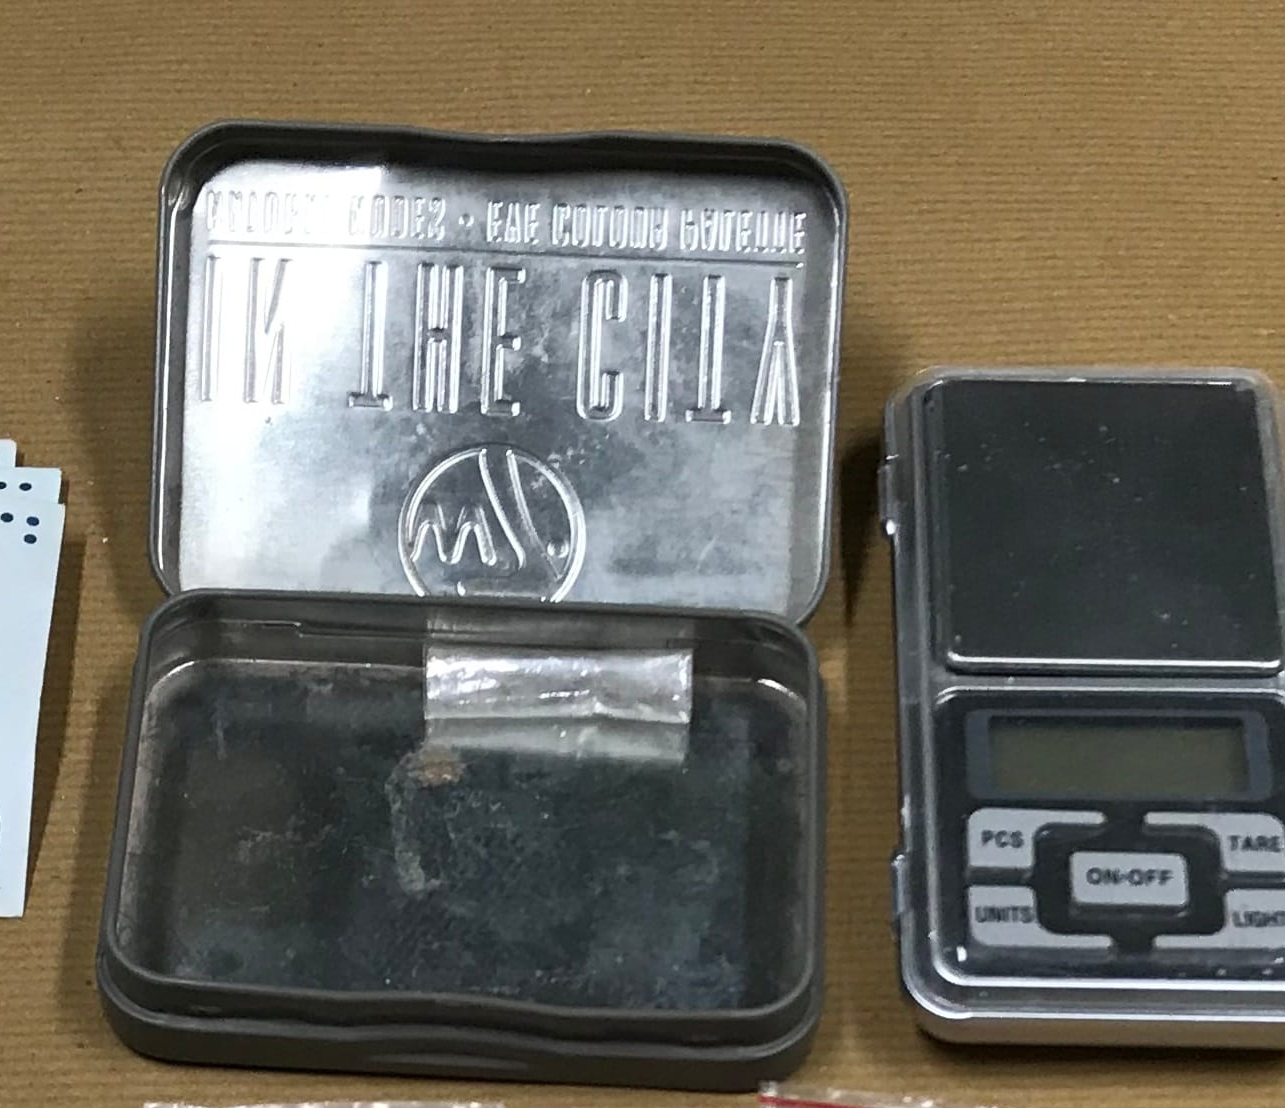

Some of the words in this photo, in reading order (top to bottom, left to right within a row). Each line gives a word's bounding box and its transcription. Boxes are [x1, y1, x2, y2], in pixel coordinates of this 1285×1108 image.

[979, 829, 1026, 850] PCS
[1229, 834, 1282, 853] TARE
[1085, 866, 1174, 887] ON-OFF
[974, 904, 1034, 924] UNITS
